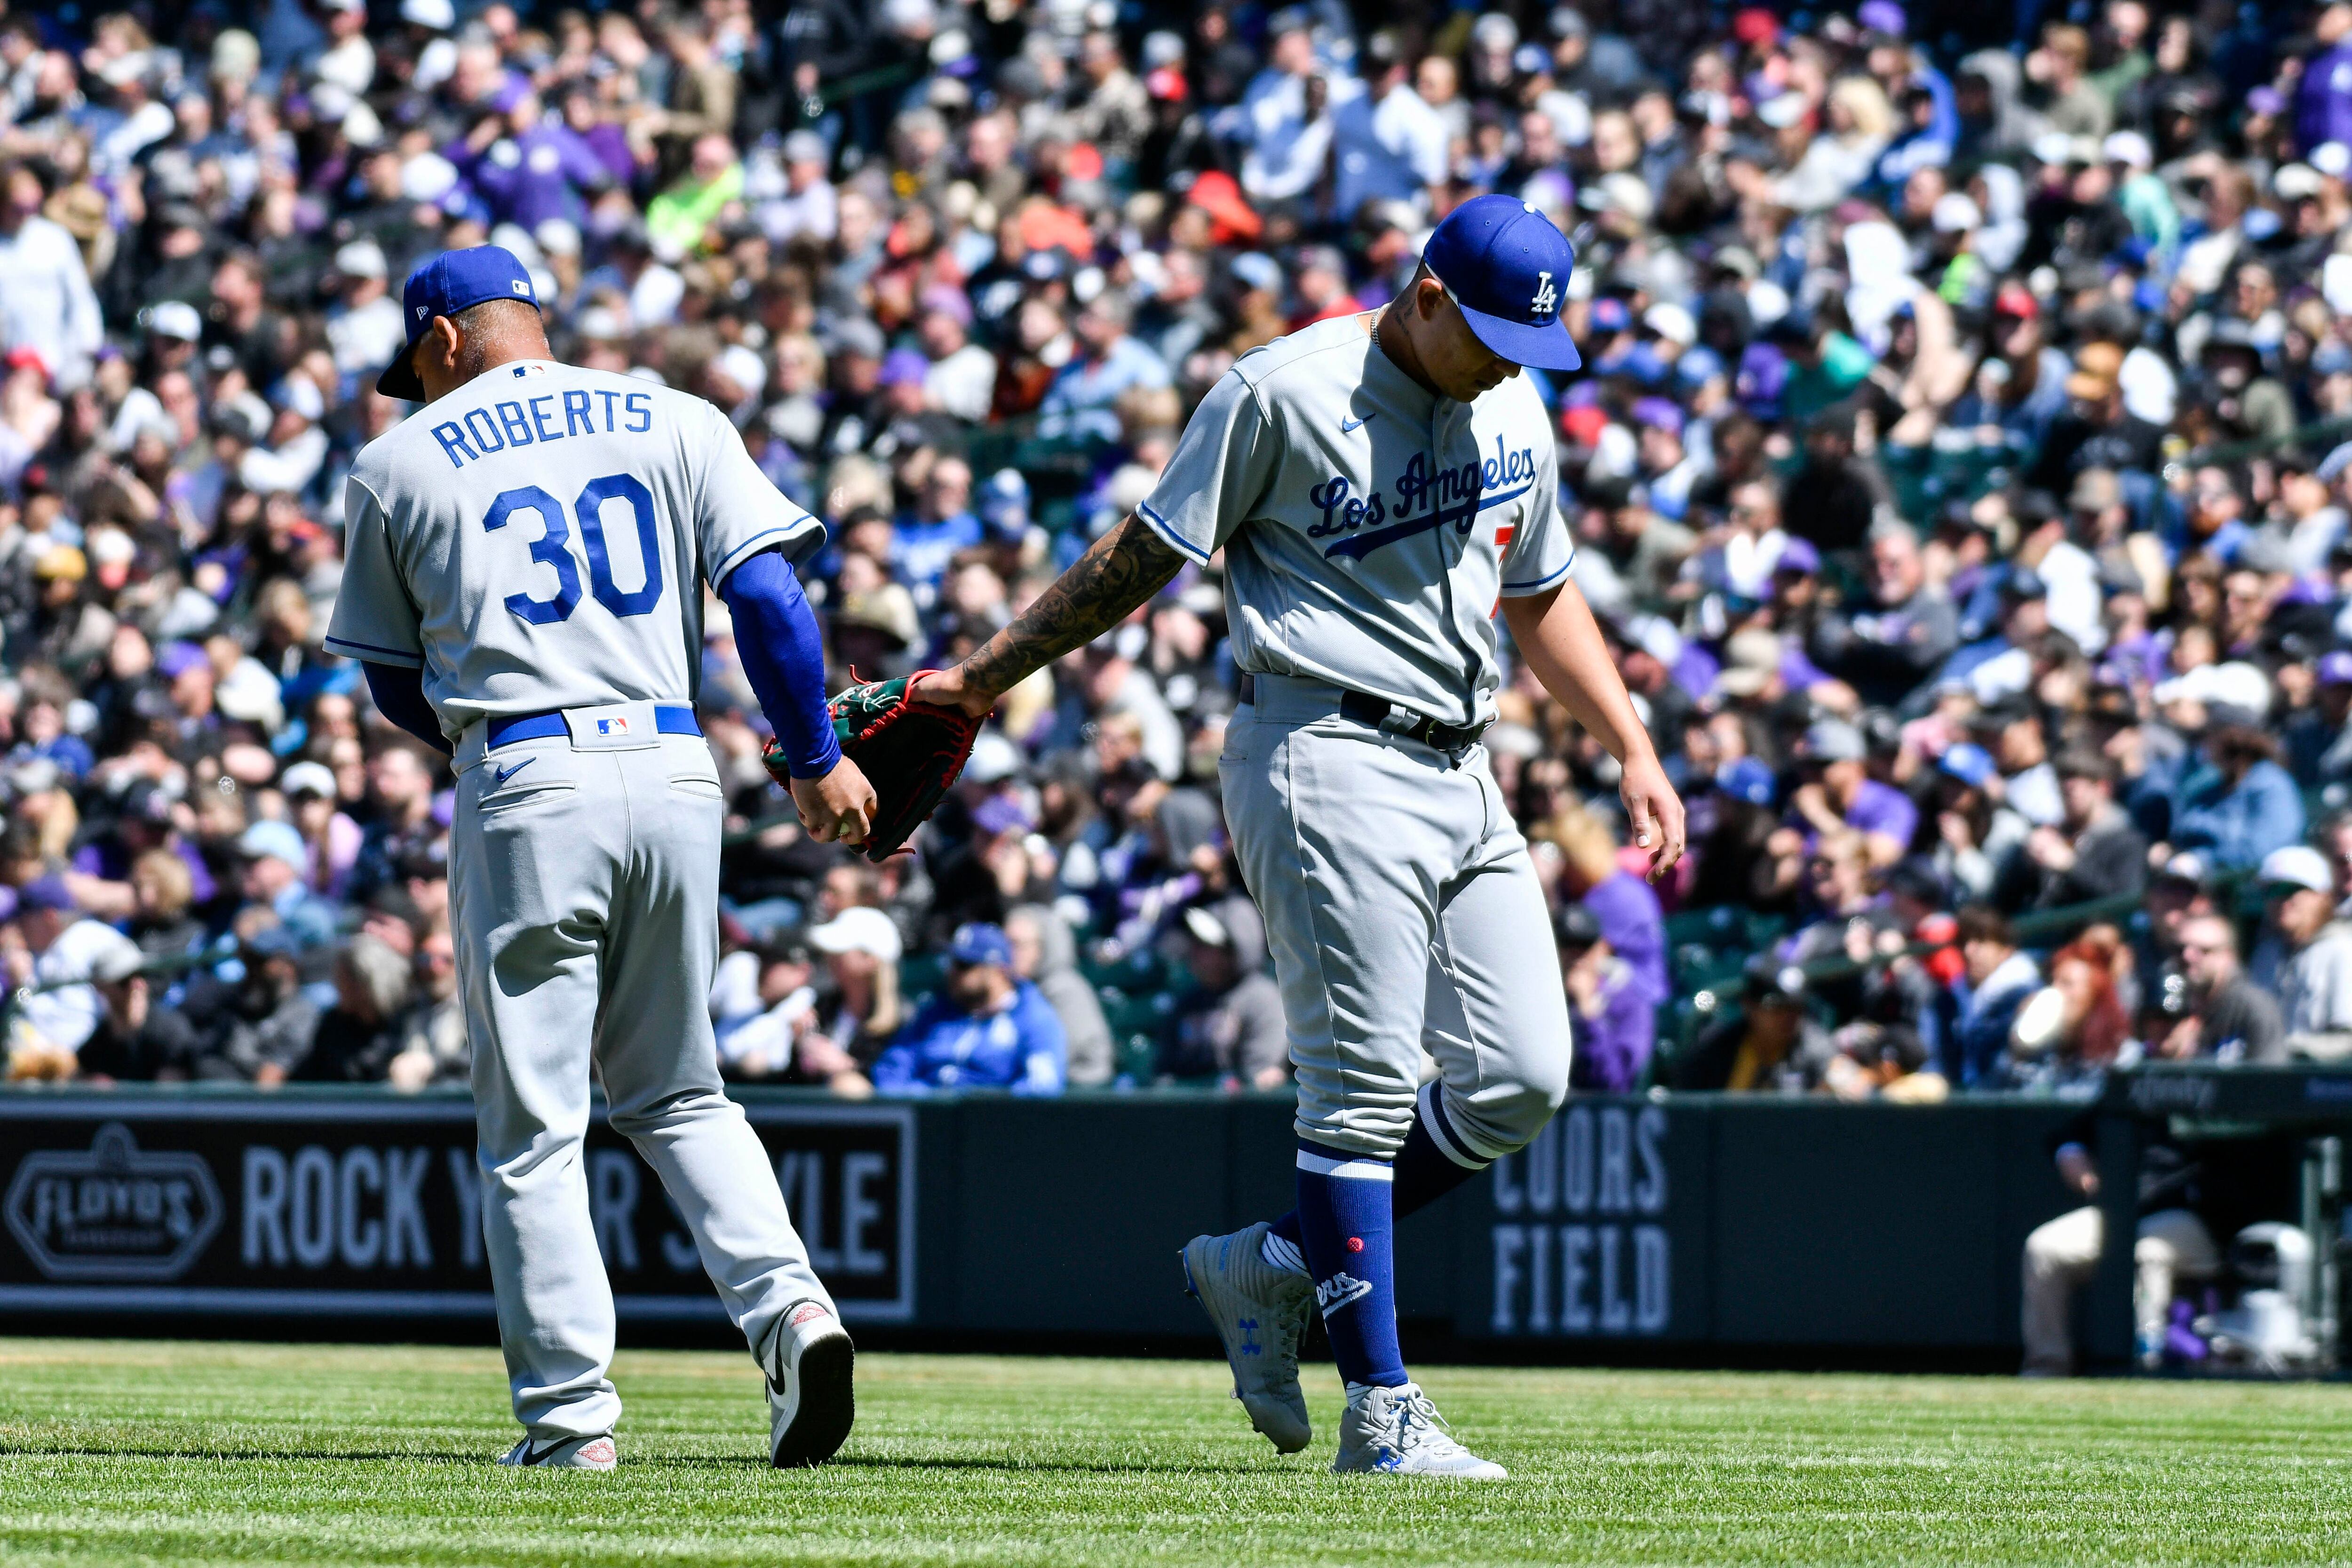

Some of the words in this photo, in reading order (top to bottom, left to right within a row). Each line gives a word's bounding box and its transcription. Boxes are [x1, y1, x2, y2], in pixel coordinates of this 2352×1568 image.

[1531, 271, 1557, 313] LA
[430, 389, 652, 468] ROBERTS
[1307, 476, 1385, 538] Los
[1393, 432, 1536, 535] Angeles
[483, 473, 663, 625] 30
[243, 1146, 433, 1267] ROCK
[447, 1147, 639, 1269] YR
[1493, 1226, 1669, 1330] FIELD
